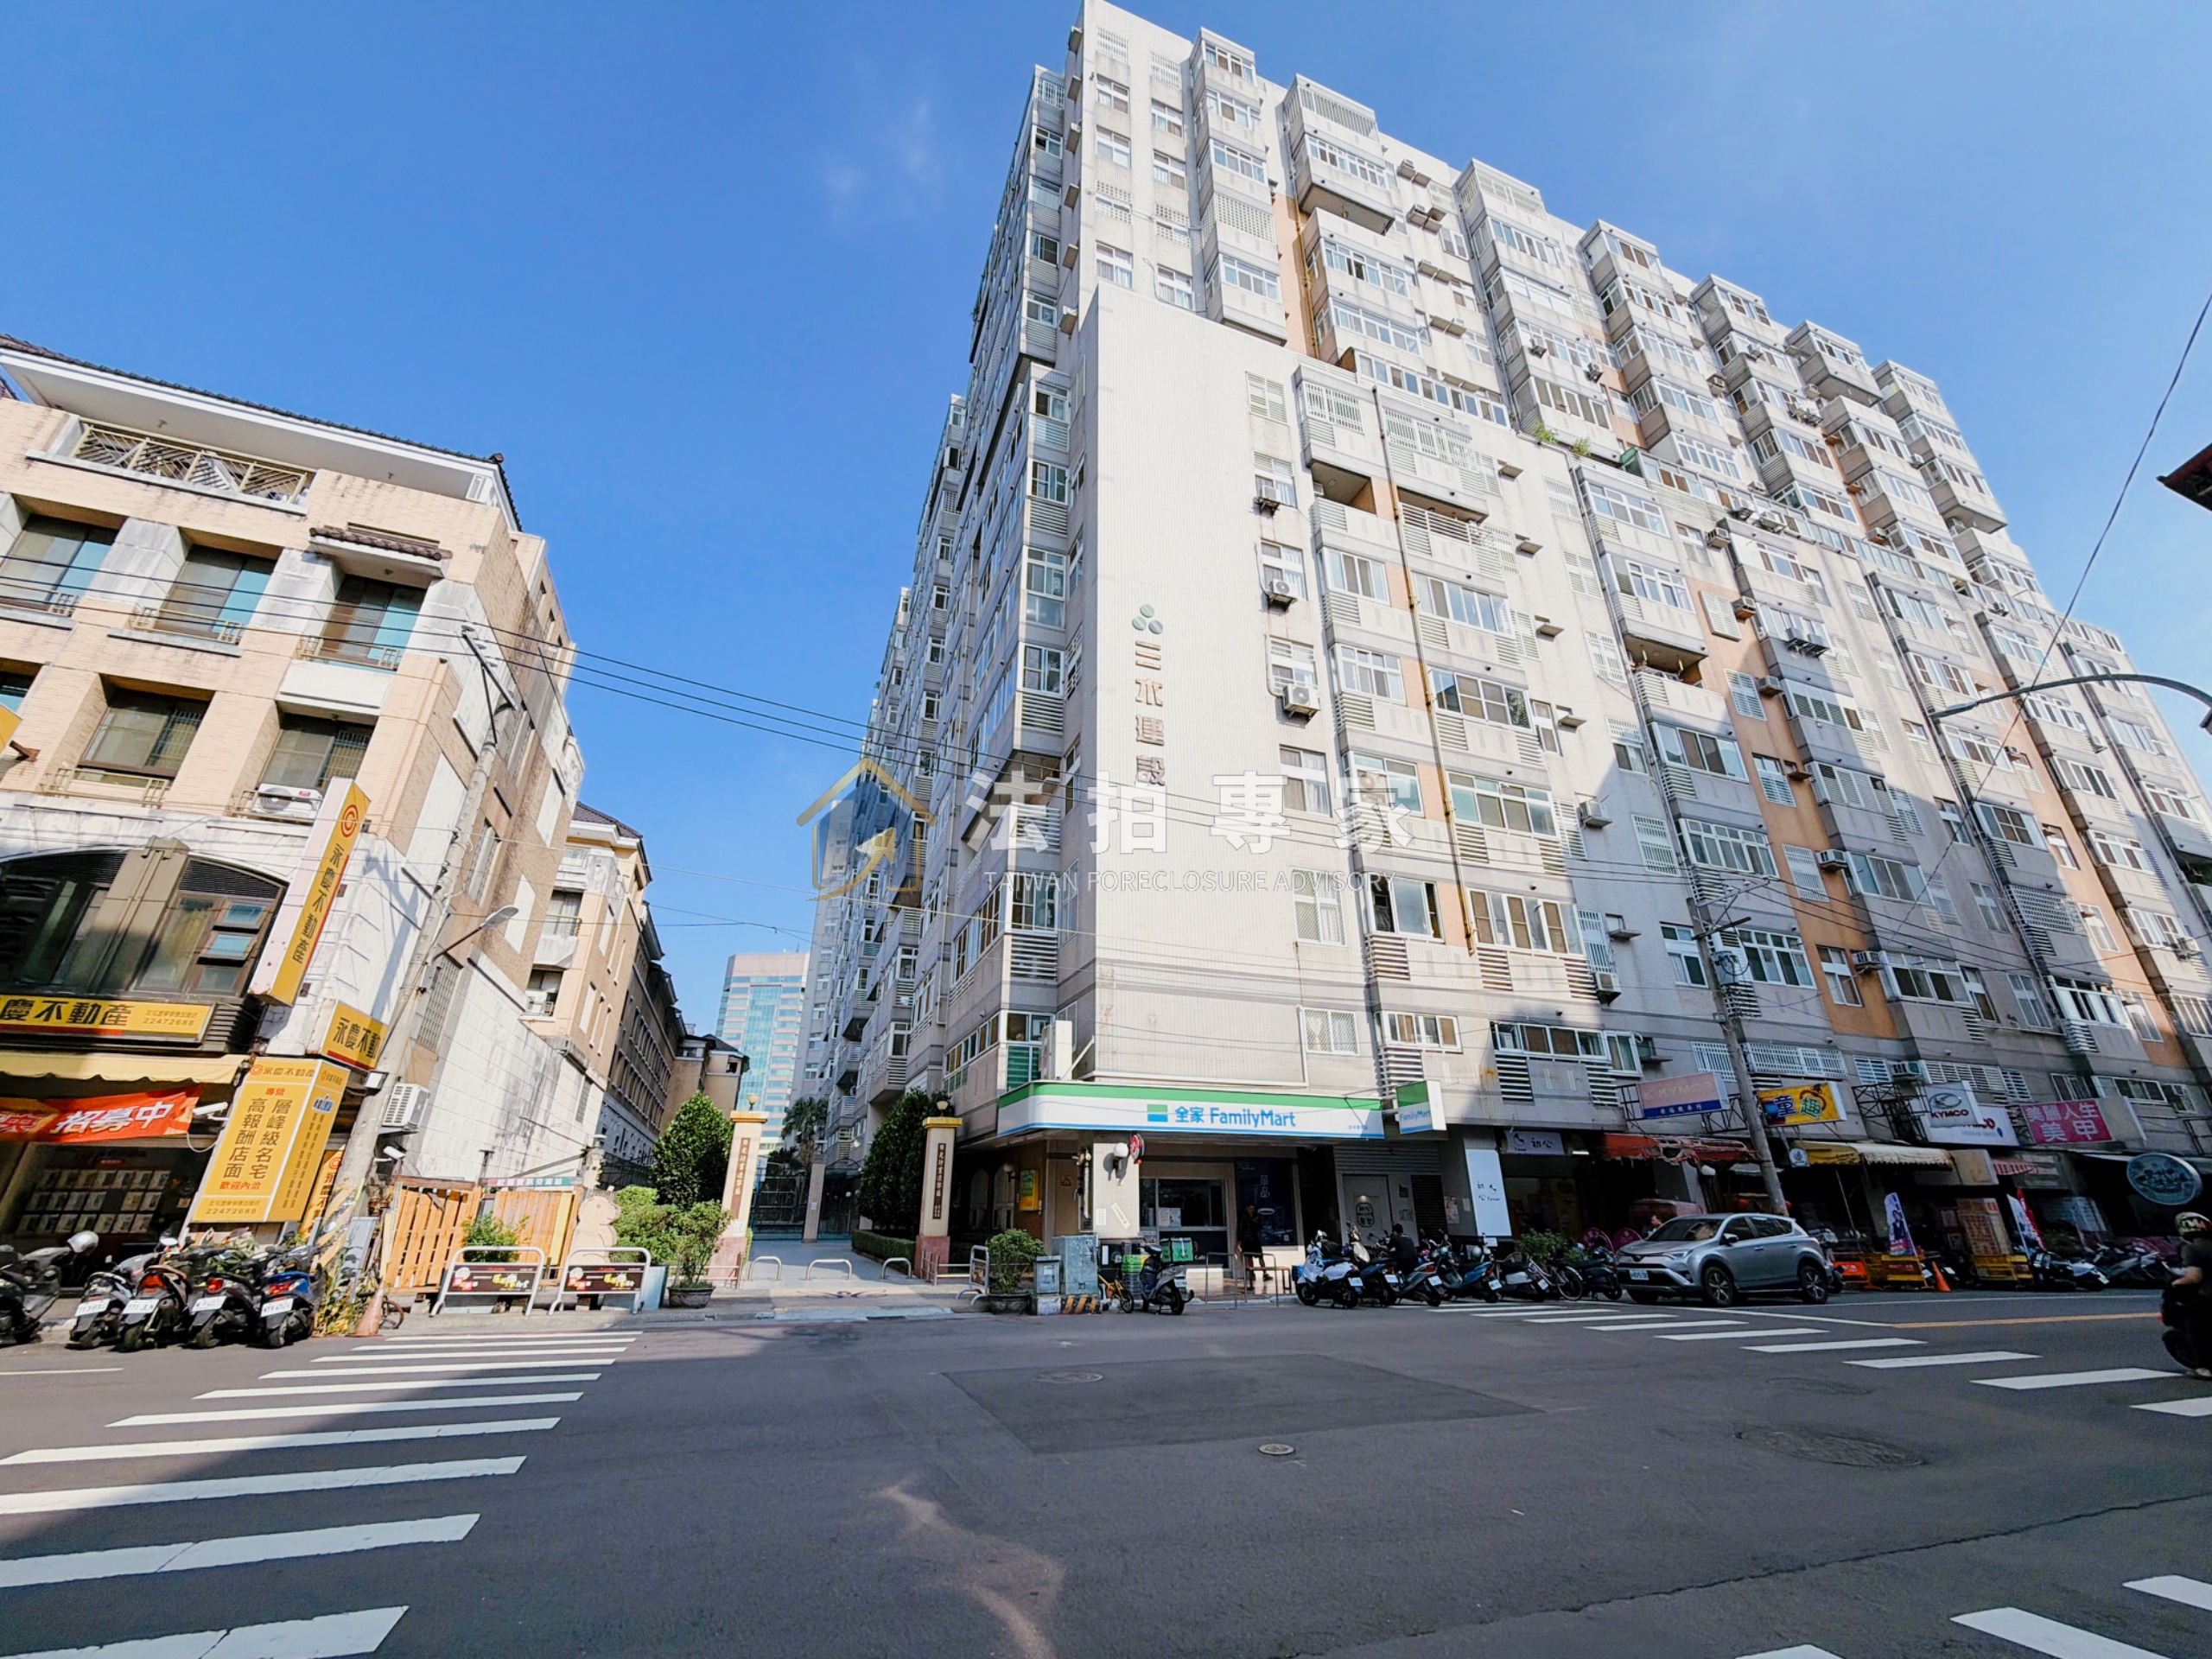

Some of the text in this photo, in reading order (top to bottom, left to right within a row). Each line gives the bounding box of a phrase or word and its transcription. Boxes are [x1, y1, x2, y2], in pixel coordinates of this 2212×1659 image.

[1135, 640, 1165, 785] 三木建設
[292, 843, 346, 964] 永慶不動產
[0, 997, 135, 1027] 慶不動產
[50, 1101, 175, 1135] 招募中
[1175, 1106, 1296, 1128] 全家 FamilyMart
[1773, 1094, 1822, 1119] 童趣
[1930, 1109, 1969, 1119] KYMCO
[223, 1098, 268, 1179] 高報酬店面
[248, 1099, 293, 1179] 層峰級名宅
[2040, 1120, 2099, 1142] 美甲
